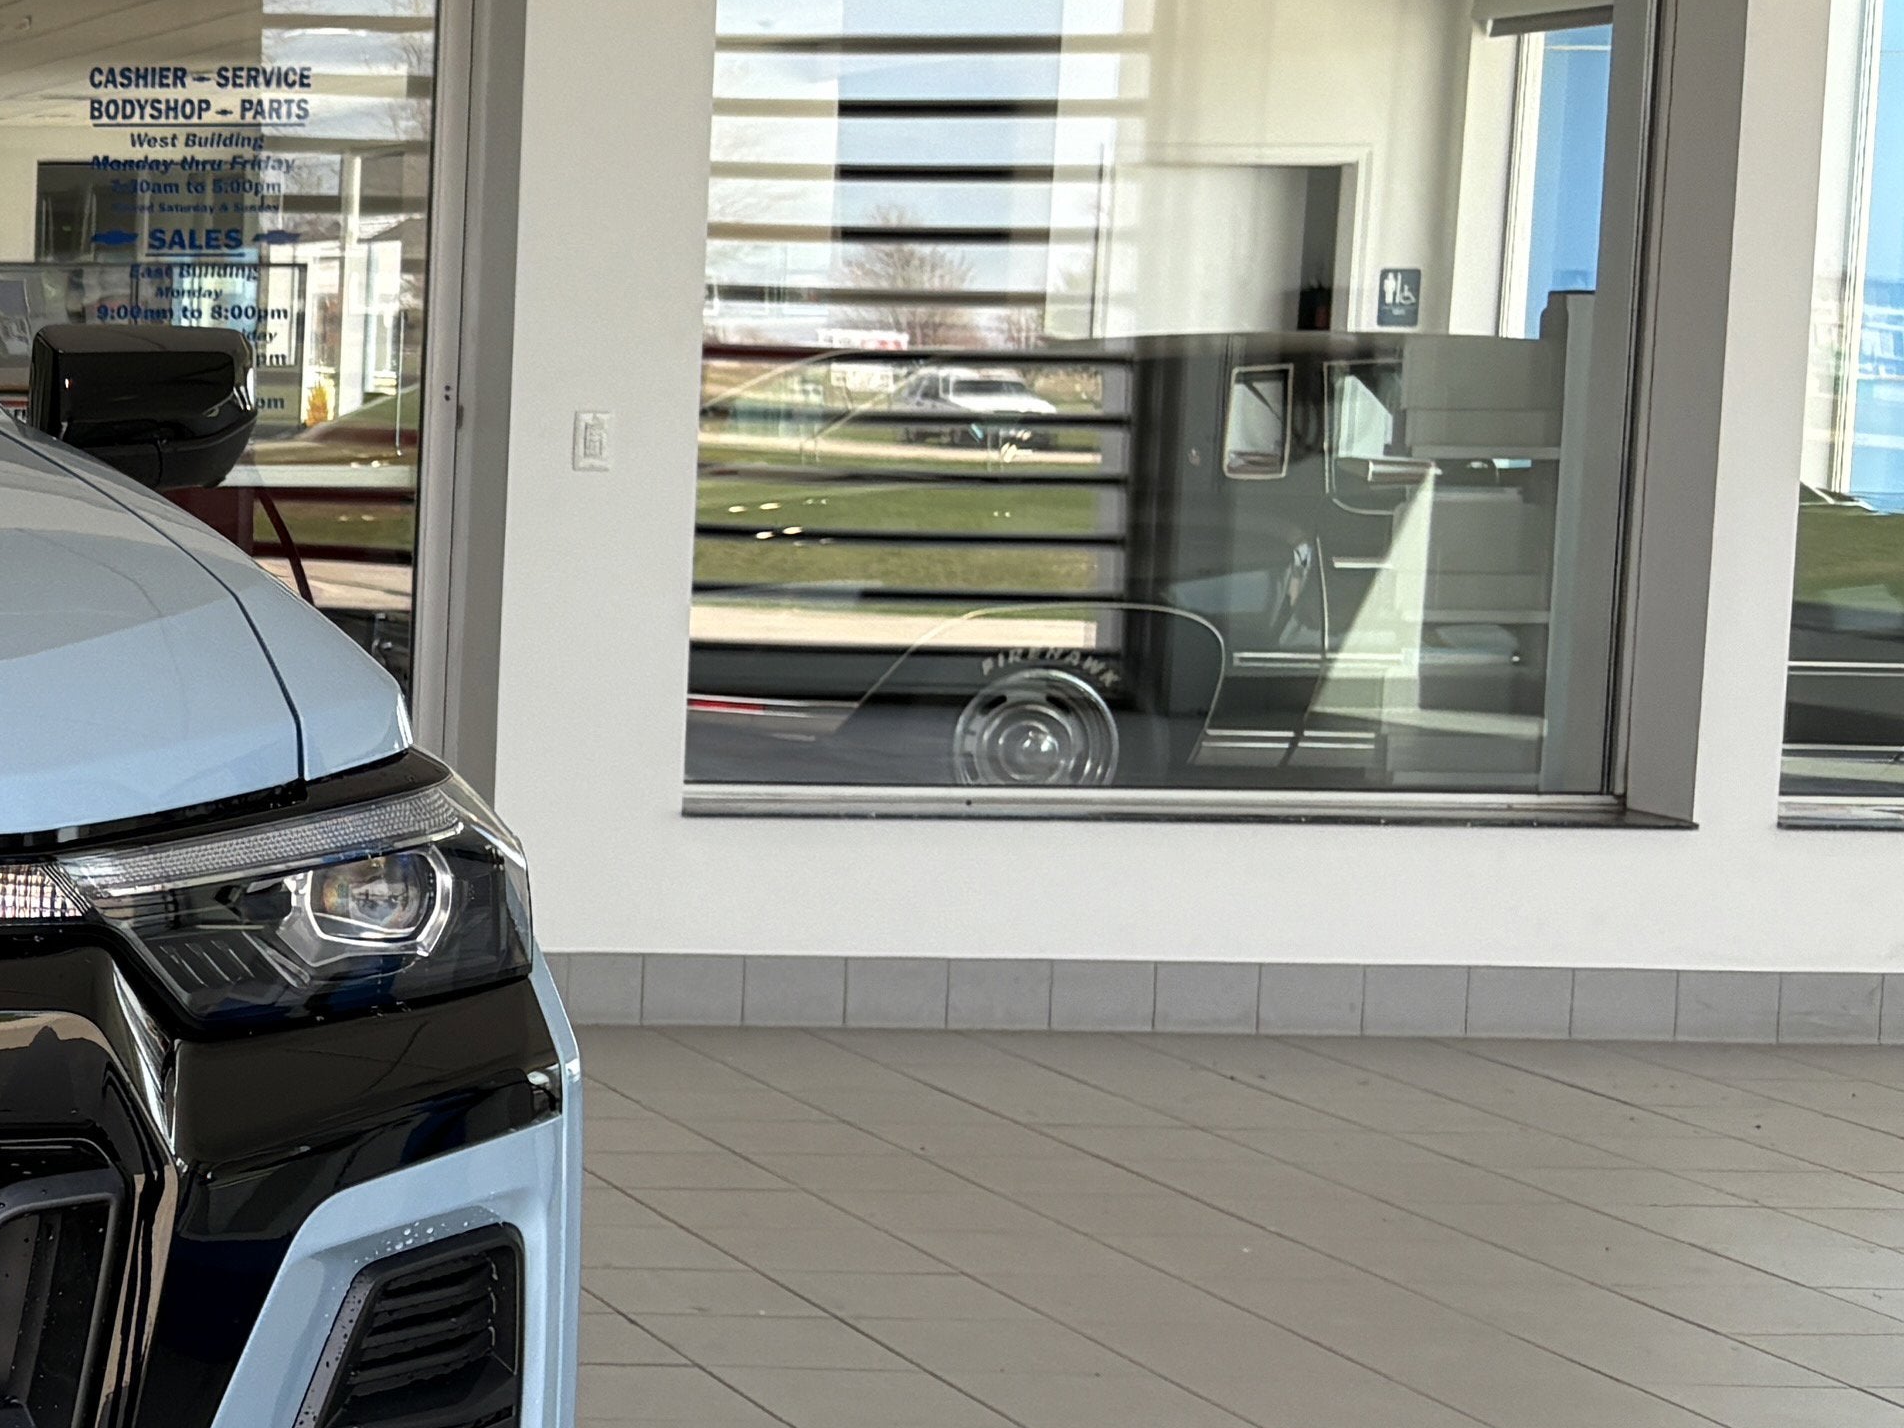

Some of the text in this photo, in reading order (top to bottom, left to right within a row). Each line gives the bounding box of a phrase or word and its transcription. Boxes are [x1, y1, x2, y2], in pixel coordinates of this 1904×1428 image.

[89, 67, 312, 88] CASHIER SERVICE
[90, 98, 310, 120] BODYSHOP PARTS
[130, 133, 265, 149] West Building
[91, 156, 295, 174] Monday thru Friday
[148, 229, 243, 250] SALES
[182, 304, 202, 320] to
